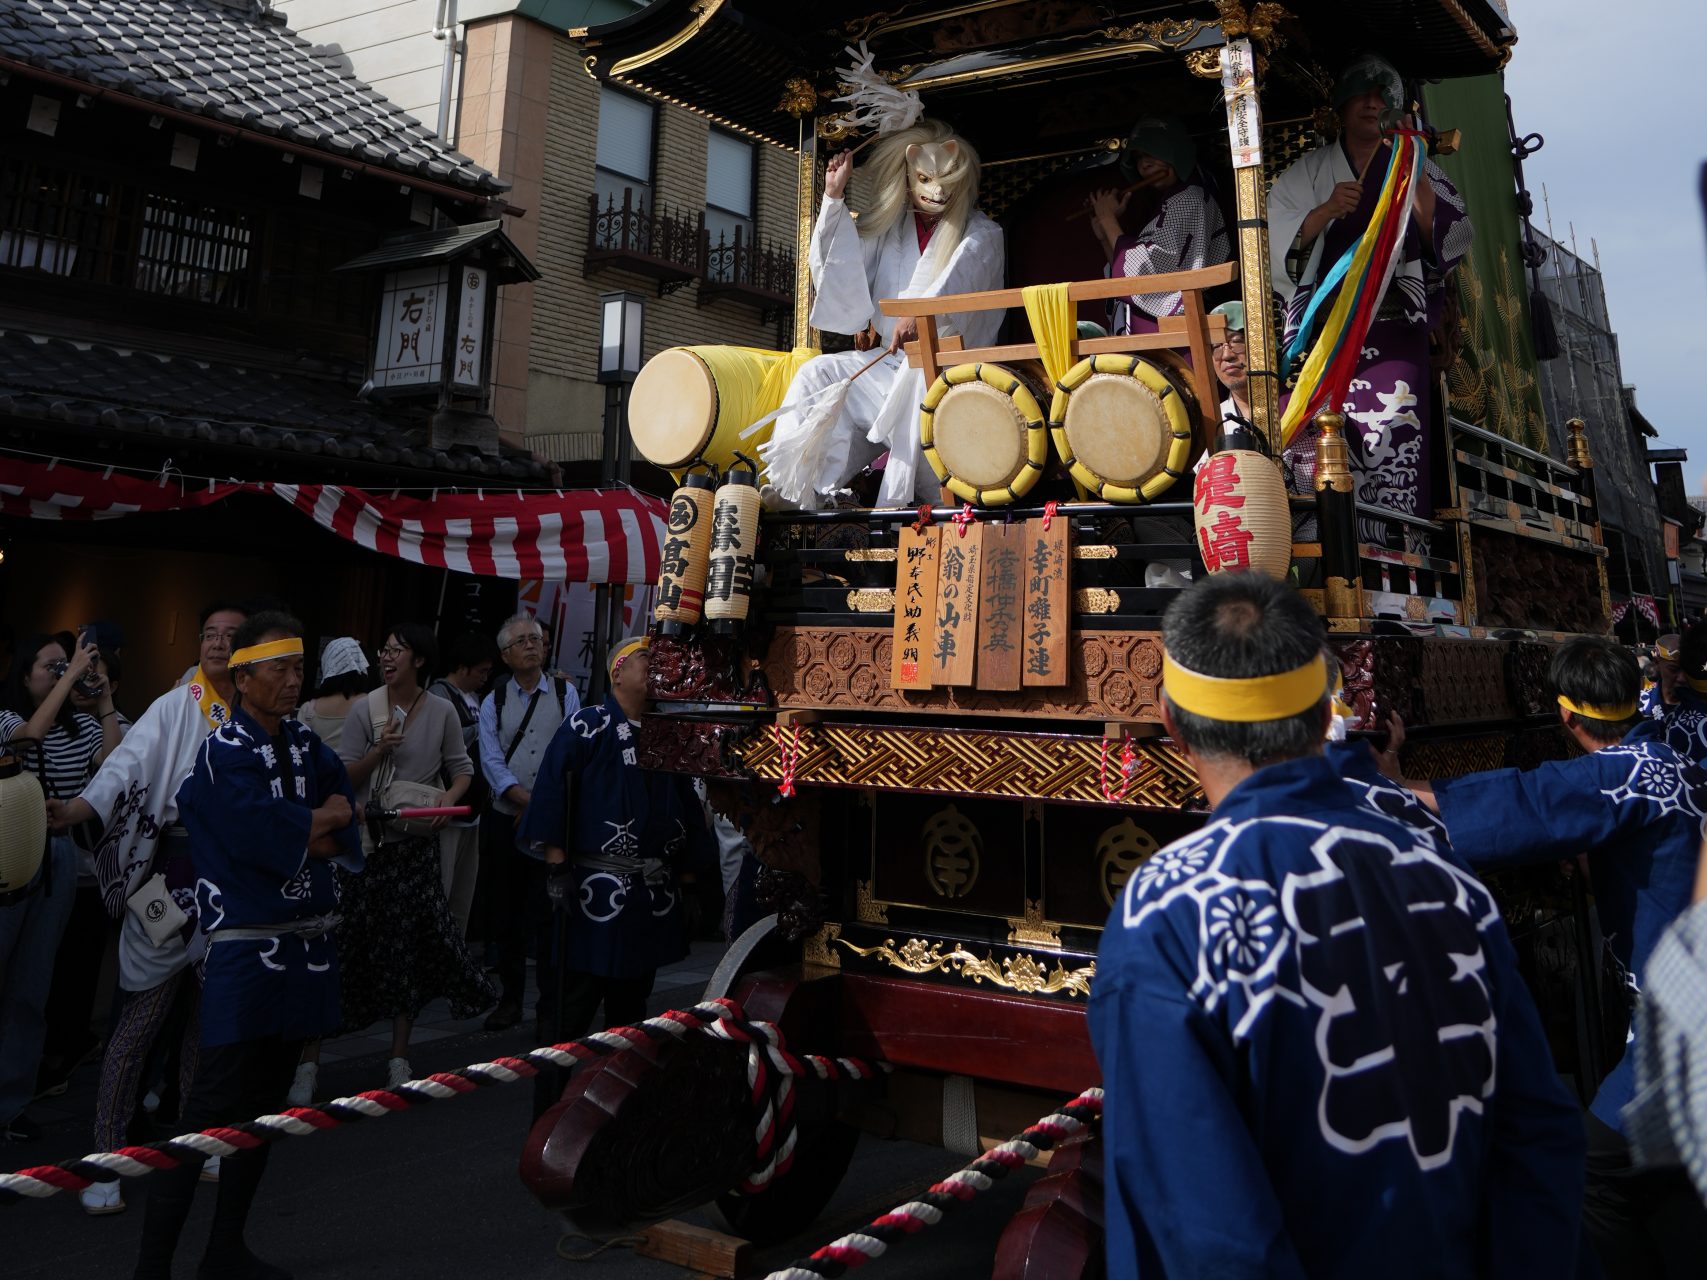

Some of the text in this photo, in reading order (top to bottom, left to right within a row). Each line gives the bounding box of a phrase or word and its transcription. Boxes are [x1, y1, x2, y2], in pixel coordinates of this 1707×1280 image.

[396, 292, 425, 363] 右門
[459, 334, 476, 381] 右門
[934, 545, 965, 669] 翁の山車
[1027, 539, 1053, 676] 幸町囃子連
